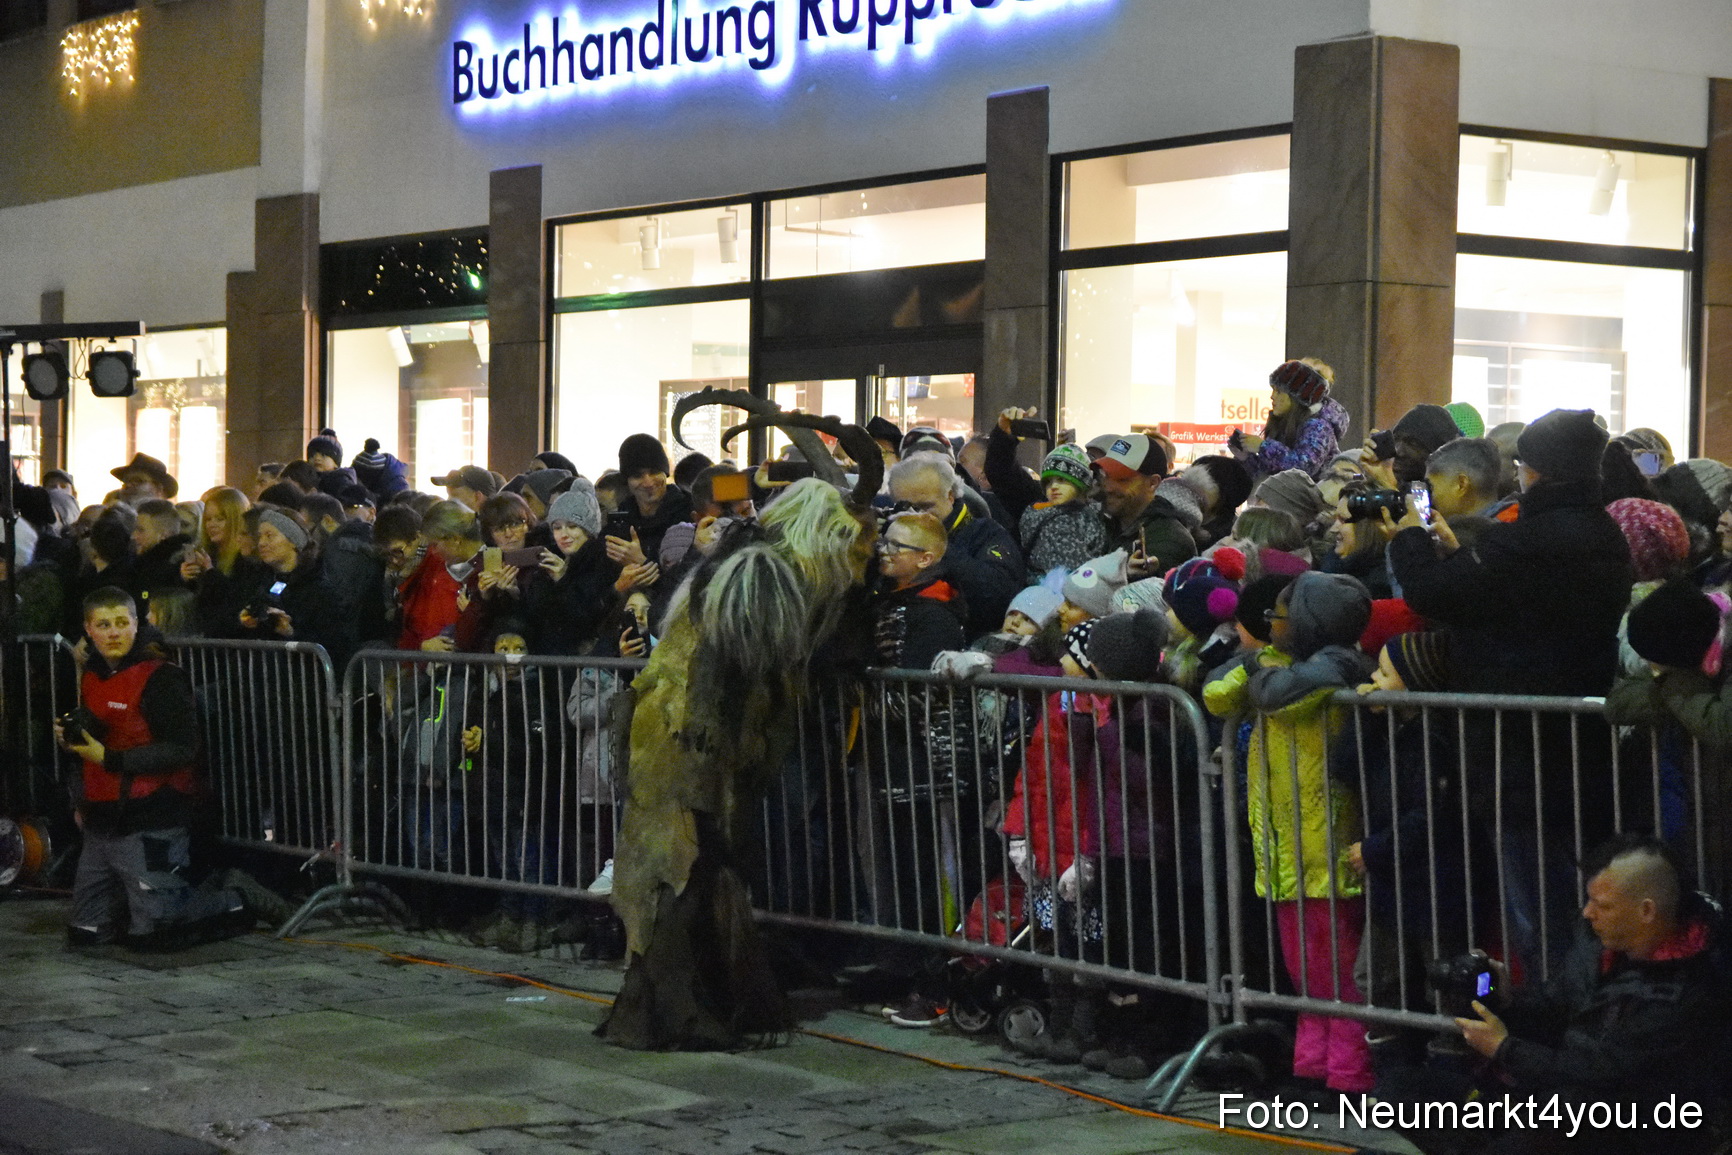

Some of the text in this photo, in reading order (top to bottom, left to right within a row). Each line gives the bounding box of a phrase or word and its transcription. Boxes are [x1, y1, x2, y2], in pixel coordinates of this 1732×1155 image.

[454, 0, 775, 104] Buchhandlung
[1170, 431, 1230, 441] Grafik Werkst
